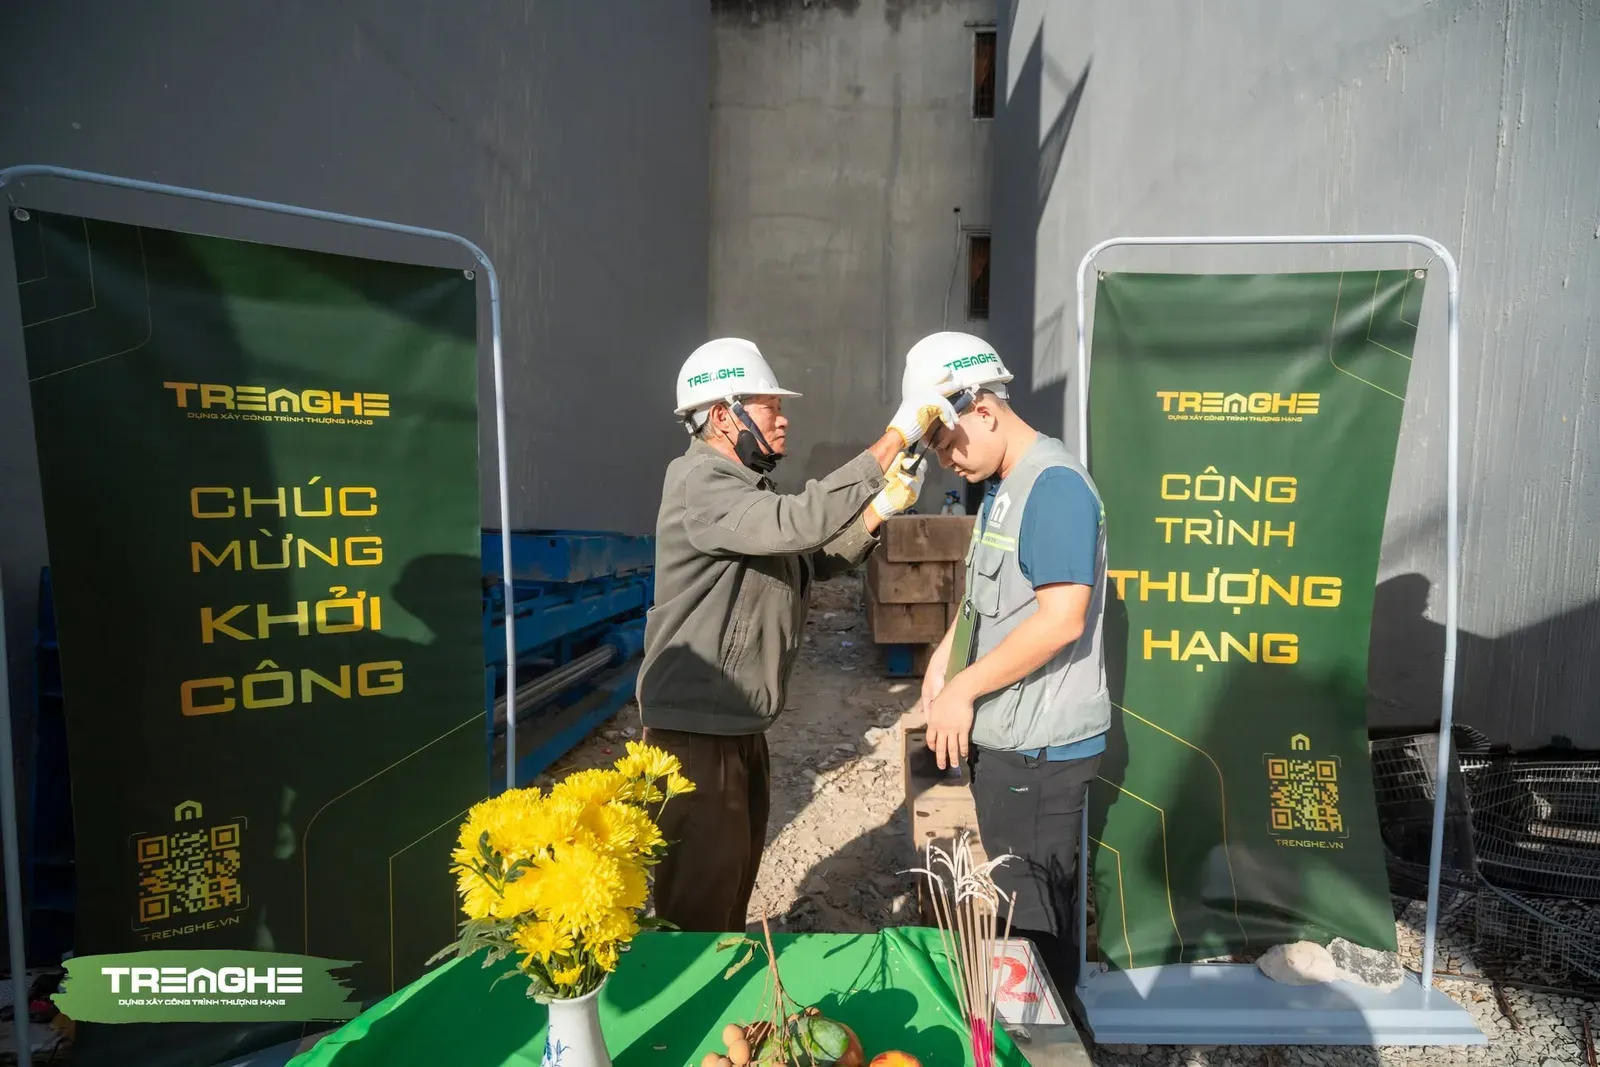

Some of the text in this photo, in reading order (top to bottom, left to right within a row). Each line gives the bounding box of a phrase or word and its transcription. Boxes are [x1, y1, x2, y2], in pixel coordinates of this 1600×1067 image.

[242, 413, 272, 422] CÔNG
[273, 415, 304, 423] TRÌNH
[190, 476, 378, 519] CHÚC
[1161, 465, 1297, 503] CÔNG
[1155, 510, 1295, 547] TRÌNH
[190, 528, 383, 573] MỪNG
[1107, 567, 1342, 615] THƯỢNG
[201, 586, 381, 644] KHỞI
[1143, 629, 1299, 672] HẠNG
[180, 659, 404, 717] CÔNG
[1276, 839, 1344, 849] TRENGHE.VN
[142, 916, 240, 942] TRENGHE.VN
